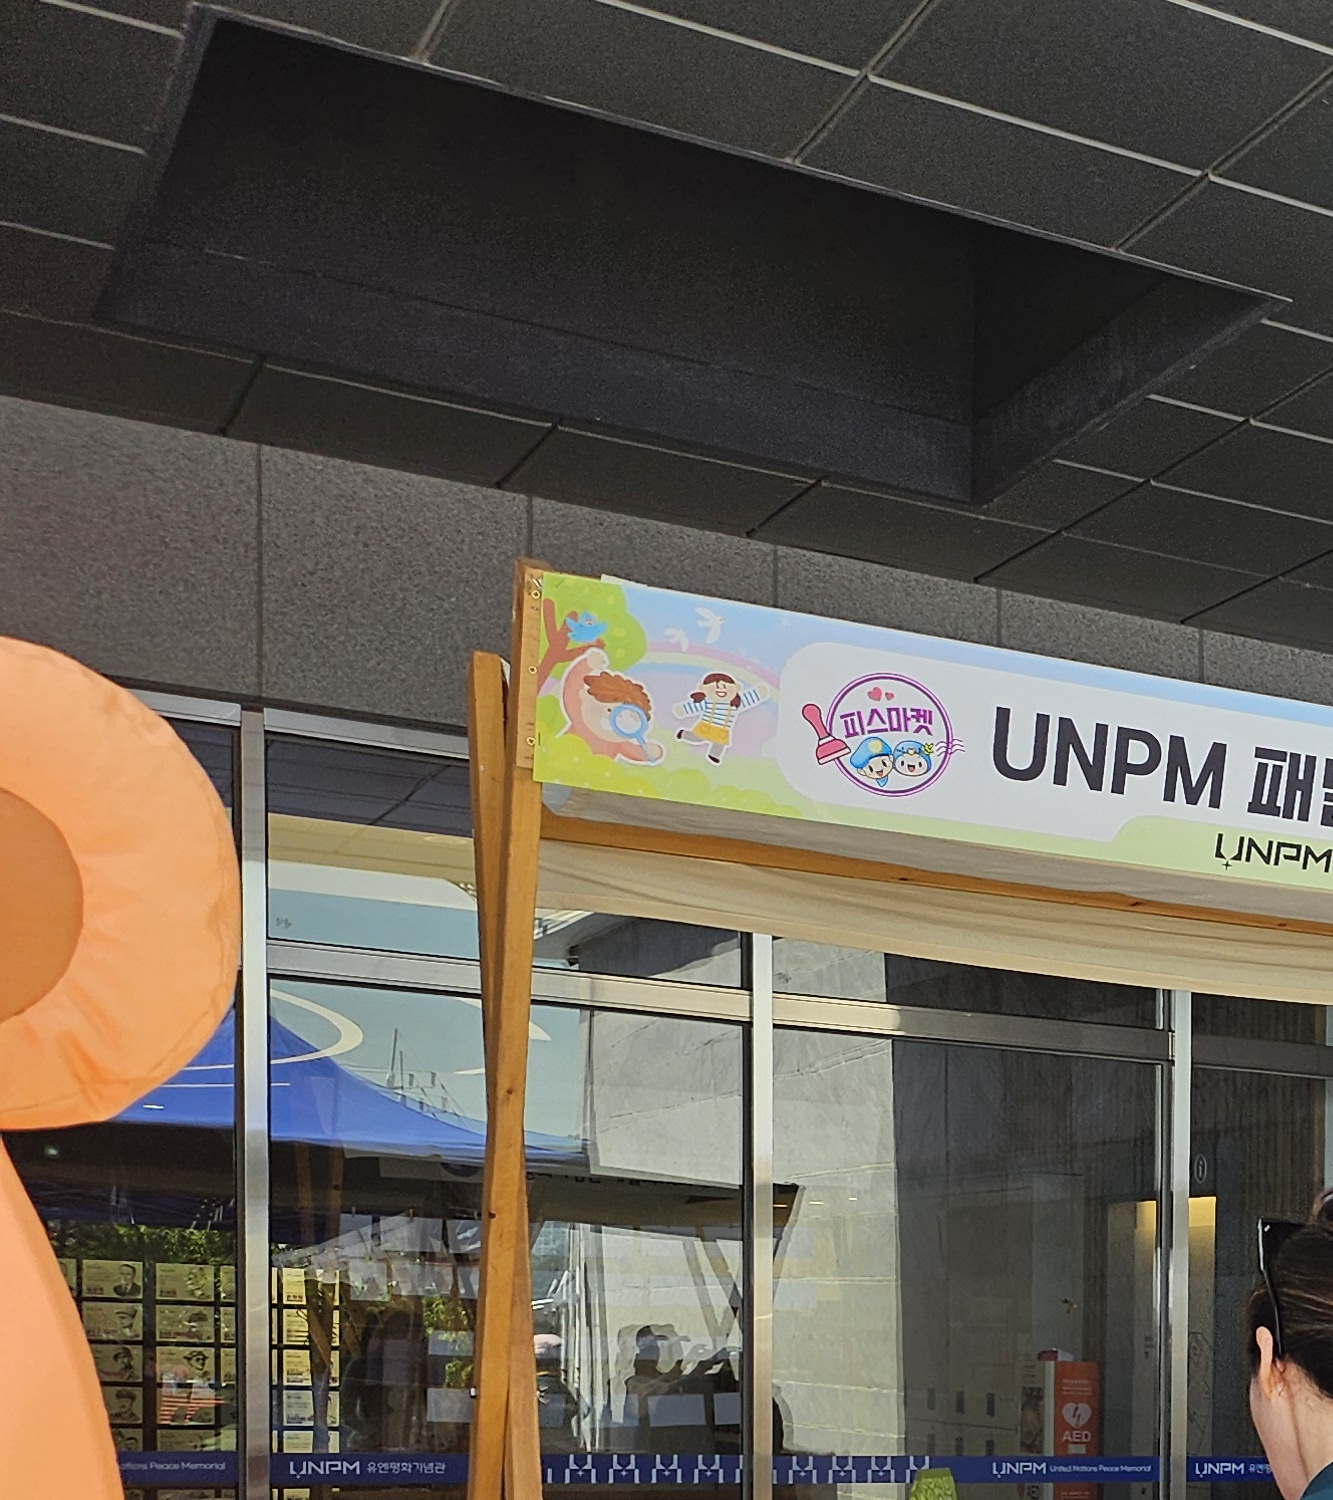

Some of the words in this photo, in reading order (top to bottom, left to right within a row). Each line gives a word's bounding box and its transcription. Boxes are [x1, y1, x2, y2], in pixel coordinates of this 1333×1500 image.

[840, 706, 933, 740] 피스마켓
[992, 706, 1227, 809] UNPM
[1215, 833, 1333, 873] UNPM
[1062, 1431, 1092, 1442] AED
[149, 1462, 178, 1471] Peace
[181, 1461, 226, 1471] Memorial
[289, 1461, 361, 1475] UNPM
[366, 1462, 447, 1475] 유엔평화기념관
[992, 1462, 1046, 1475] UNPM
[1195, 1462, 1244, 1475] UNPM
